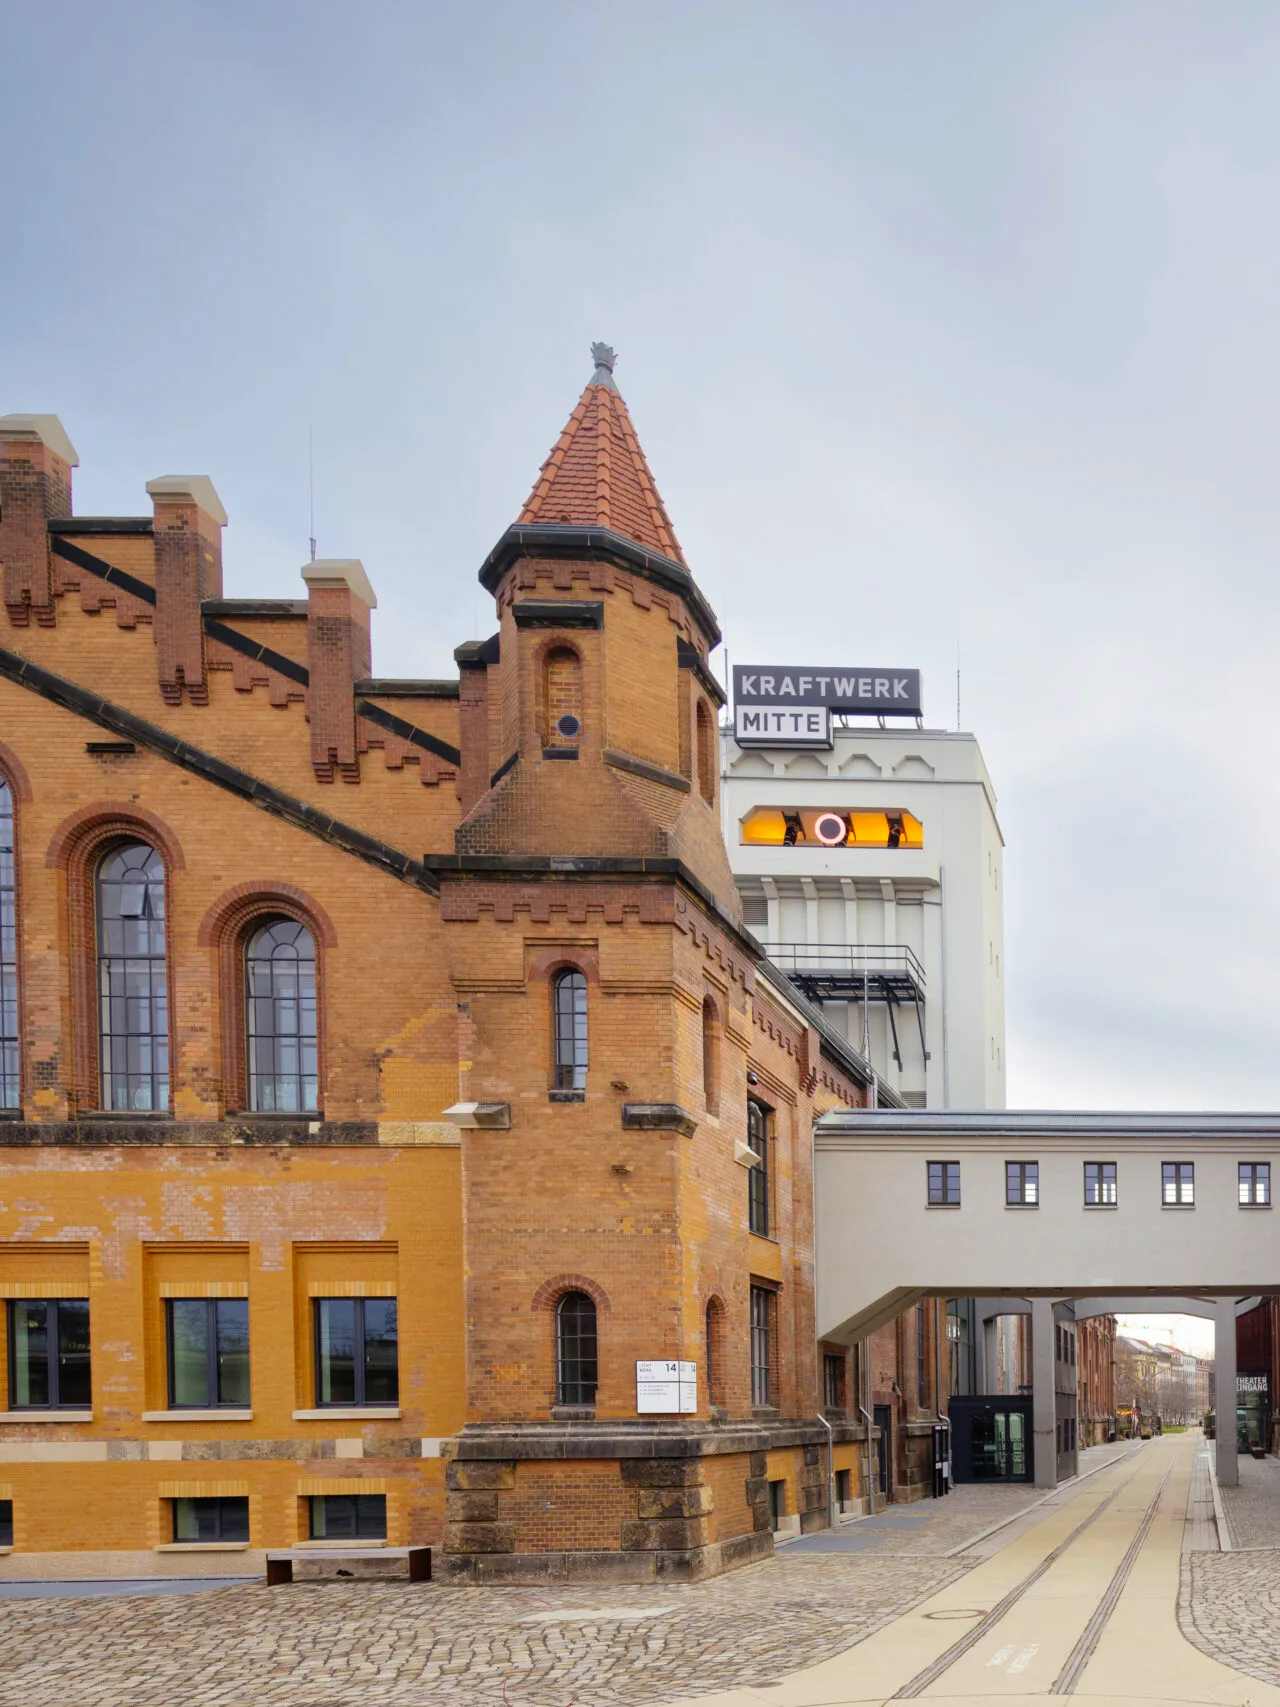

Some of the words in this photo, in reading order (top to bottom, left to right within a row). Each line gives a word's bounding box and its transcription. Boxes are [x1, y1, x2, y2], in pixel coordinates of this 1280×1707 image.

[741, 675, 910, 699] KRAFTWERK
[742, 712, 820, 732] MITTE
[665, 1363, 677, 1372] 14
[1236, 1376, 1267, 1384] THEATER
